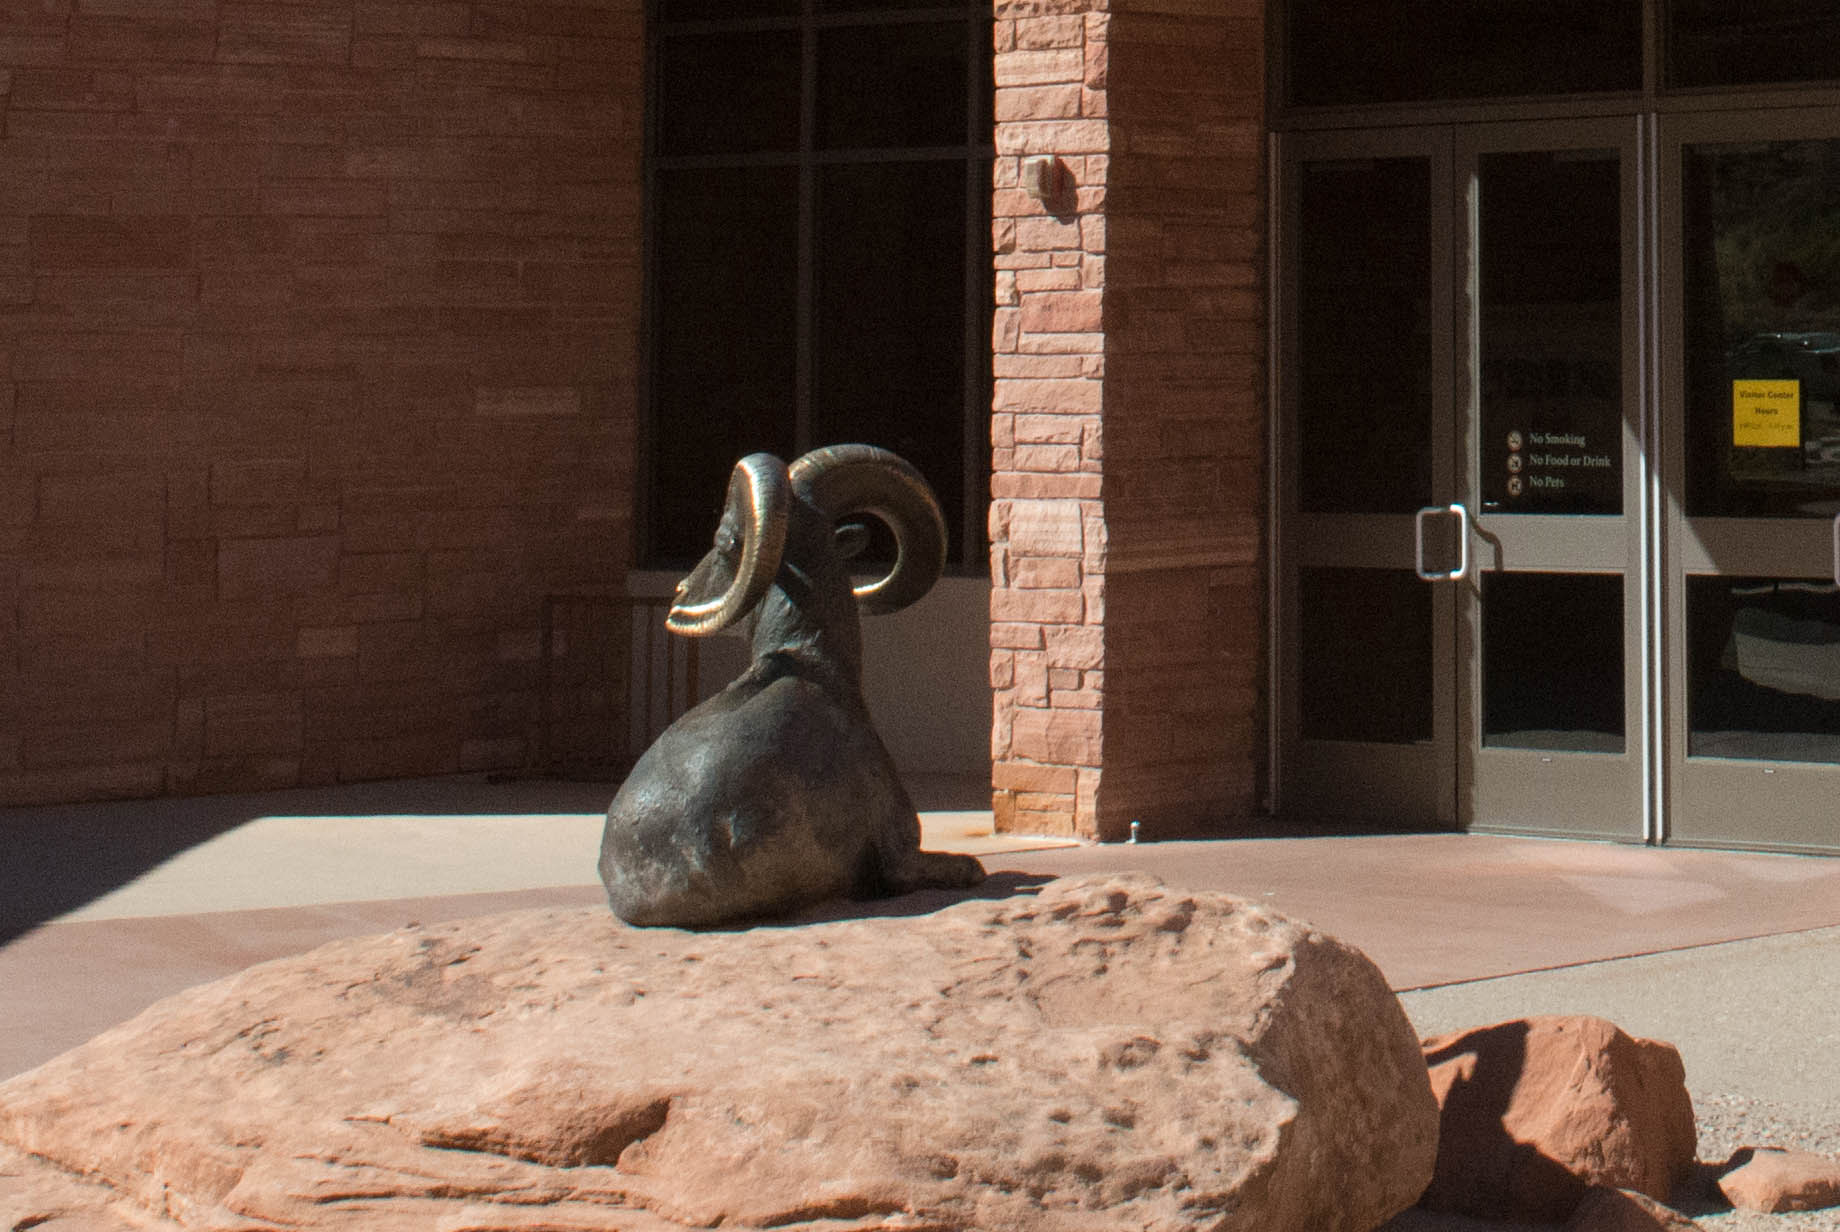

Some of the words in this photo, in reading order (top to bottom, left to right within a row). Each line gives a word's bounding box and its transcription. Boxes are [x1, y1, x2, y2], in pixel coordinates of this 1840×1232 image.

[1529, 433, 1544, 445] No
[1545, 433, 1586, 448] Smoking
[1529, 454, 1544, 465] No
[1545, 454, 1569, 466] Food
[1570, 457, 1582, 466] or
[1583, 455, 1611, 467] Drink
[1529, 475, 1544, 487] No
[1545, 475, 1565, 488] Pets
